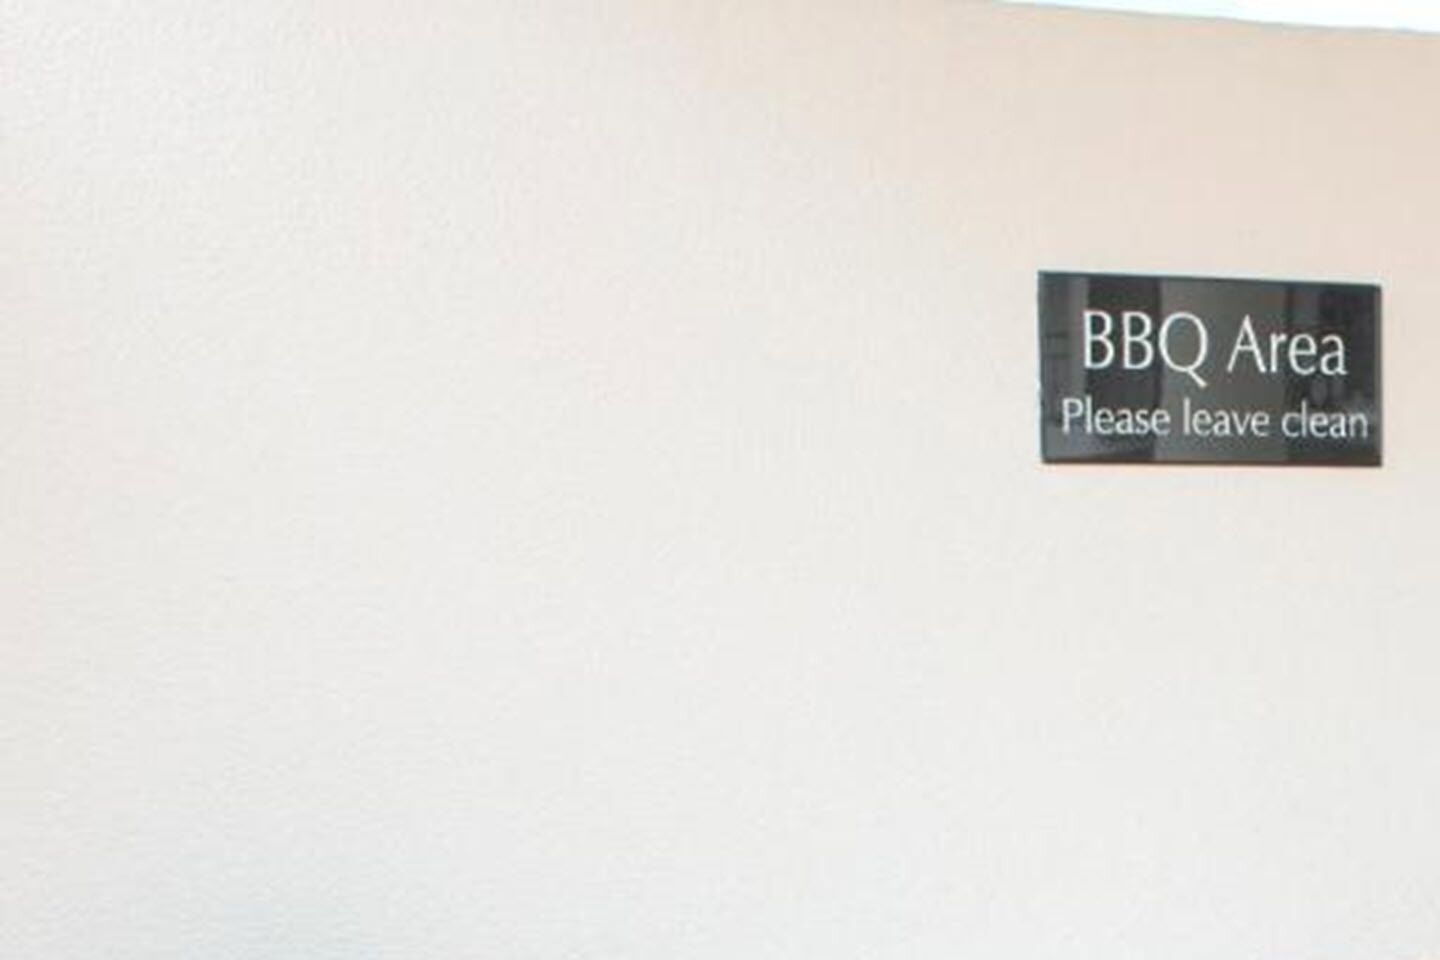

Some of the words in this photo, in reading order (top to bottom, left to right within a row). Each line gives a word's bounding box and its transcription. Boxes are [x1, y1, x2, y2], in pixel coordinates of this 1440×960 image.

[1083, 310, 1208, 388] BBQ
[1228, 315, 1348, 376] Area
[1062, 396, 1171, 436] Please
[1183, 397, 1270, 437] leave
[1281, 400, 1368, 438] clean
